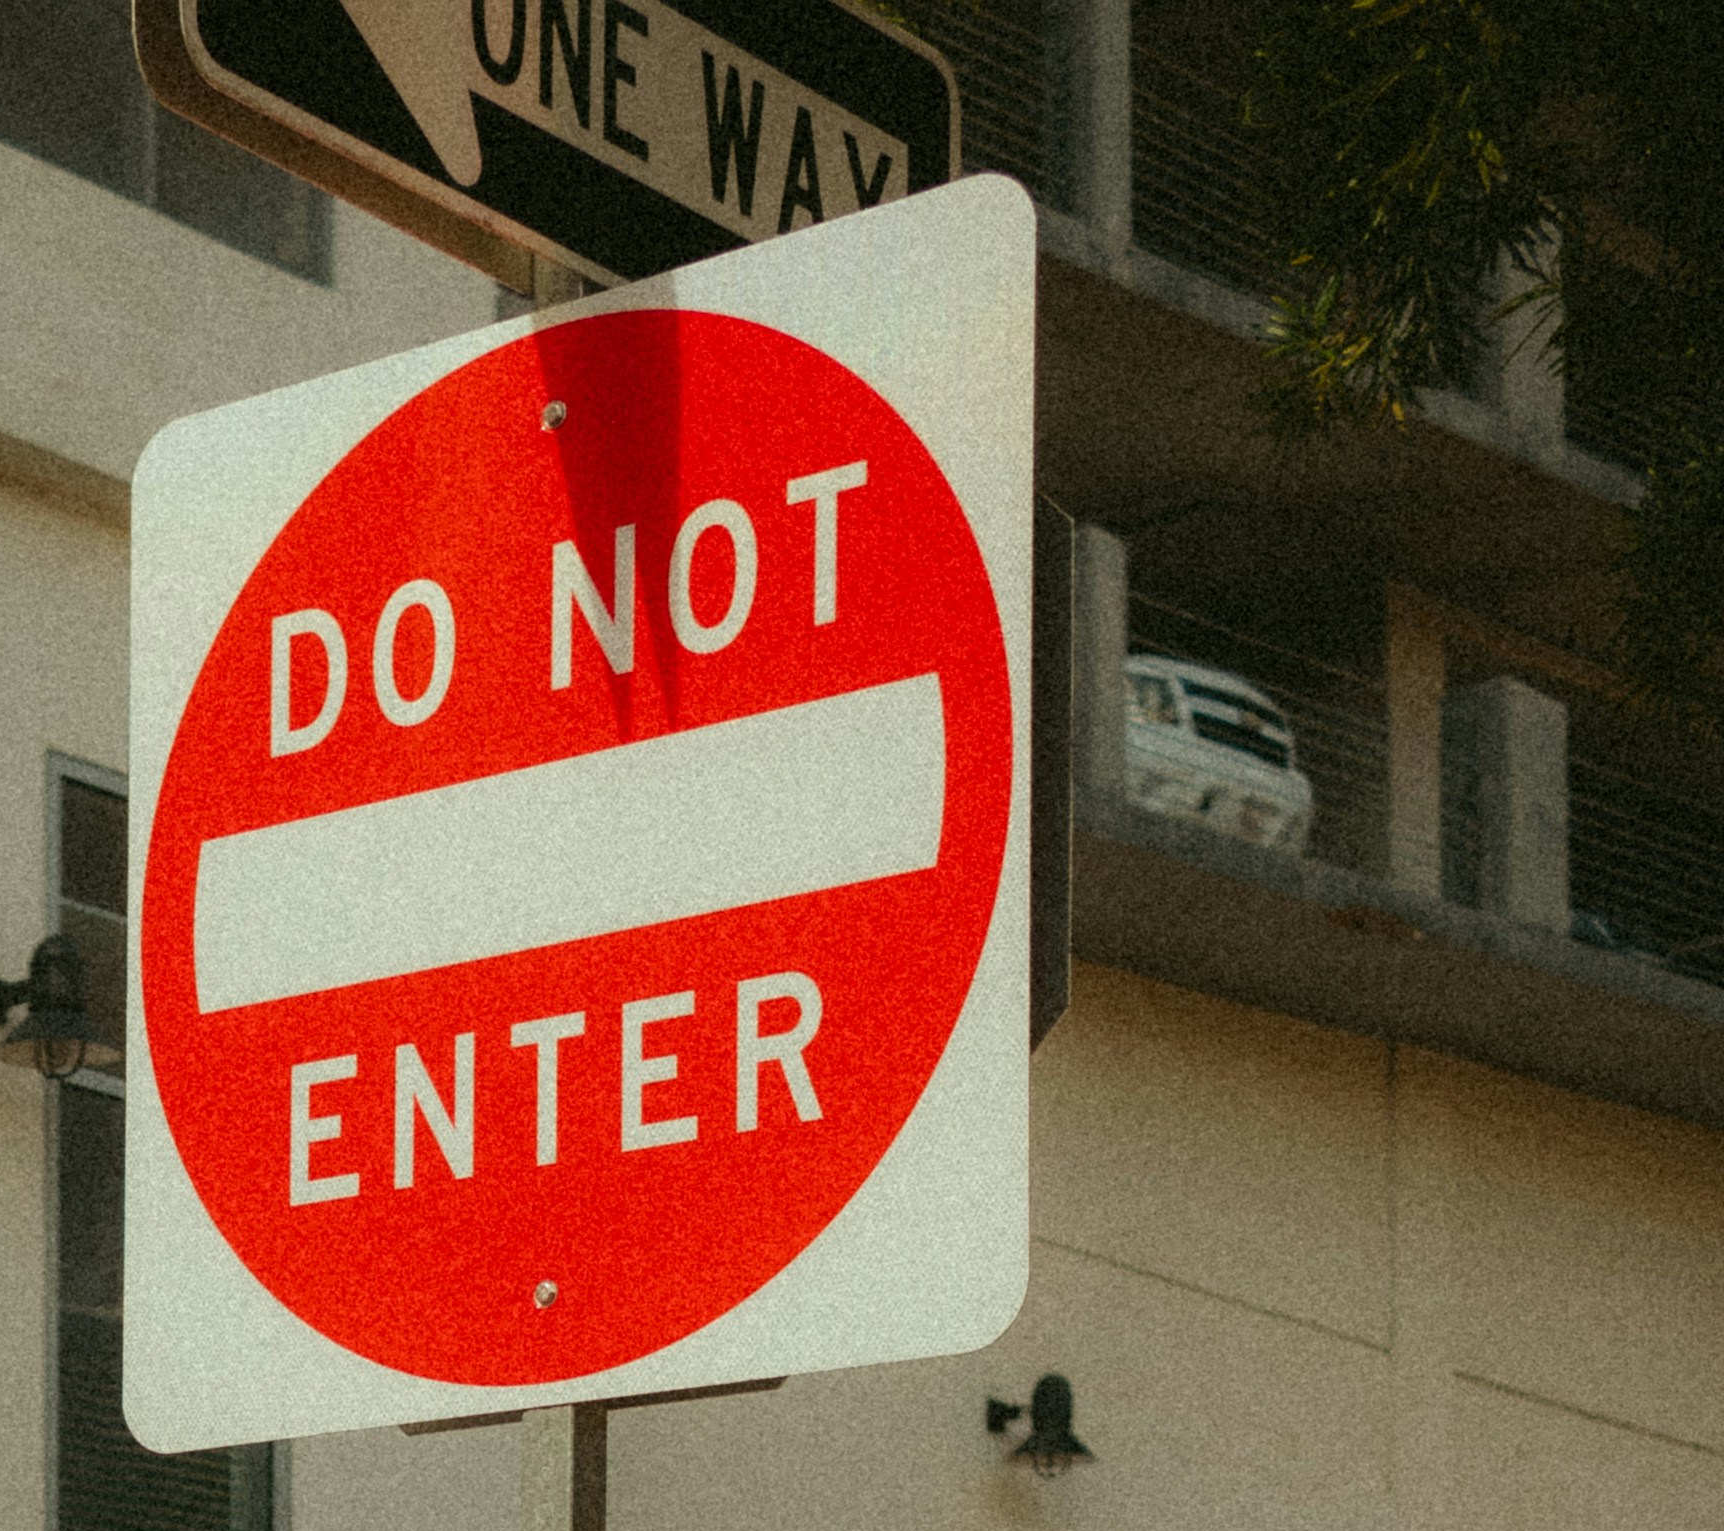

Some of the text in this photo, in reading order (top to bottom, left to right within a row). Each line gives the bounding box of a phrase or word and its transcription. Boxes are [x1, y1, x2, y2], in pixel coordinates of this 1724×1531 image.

[471, 0, 893, 236] ONE WAY
[270, 460, 869, 758] DO NOT
[289, 971, 825, 1207] ENTER
